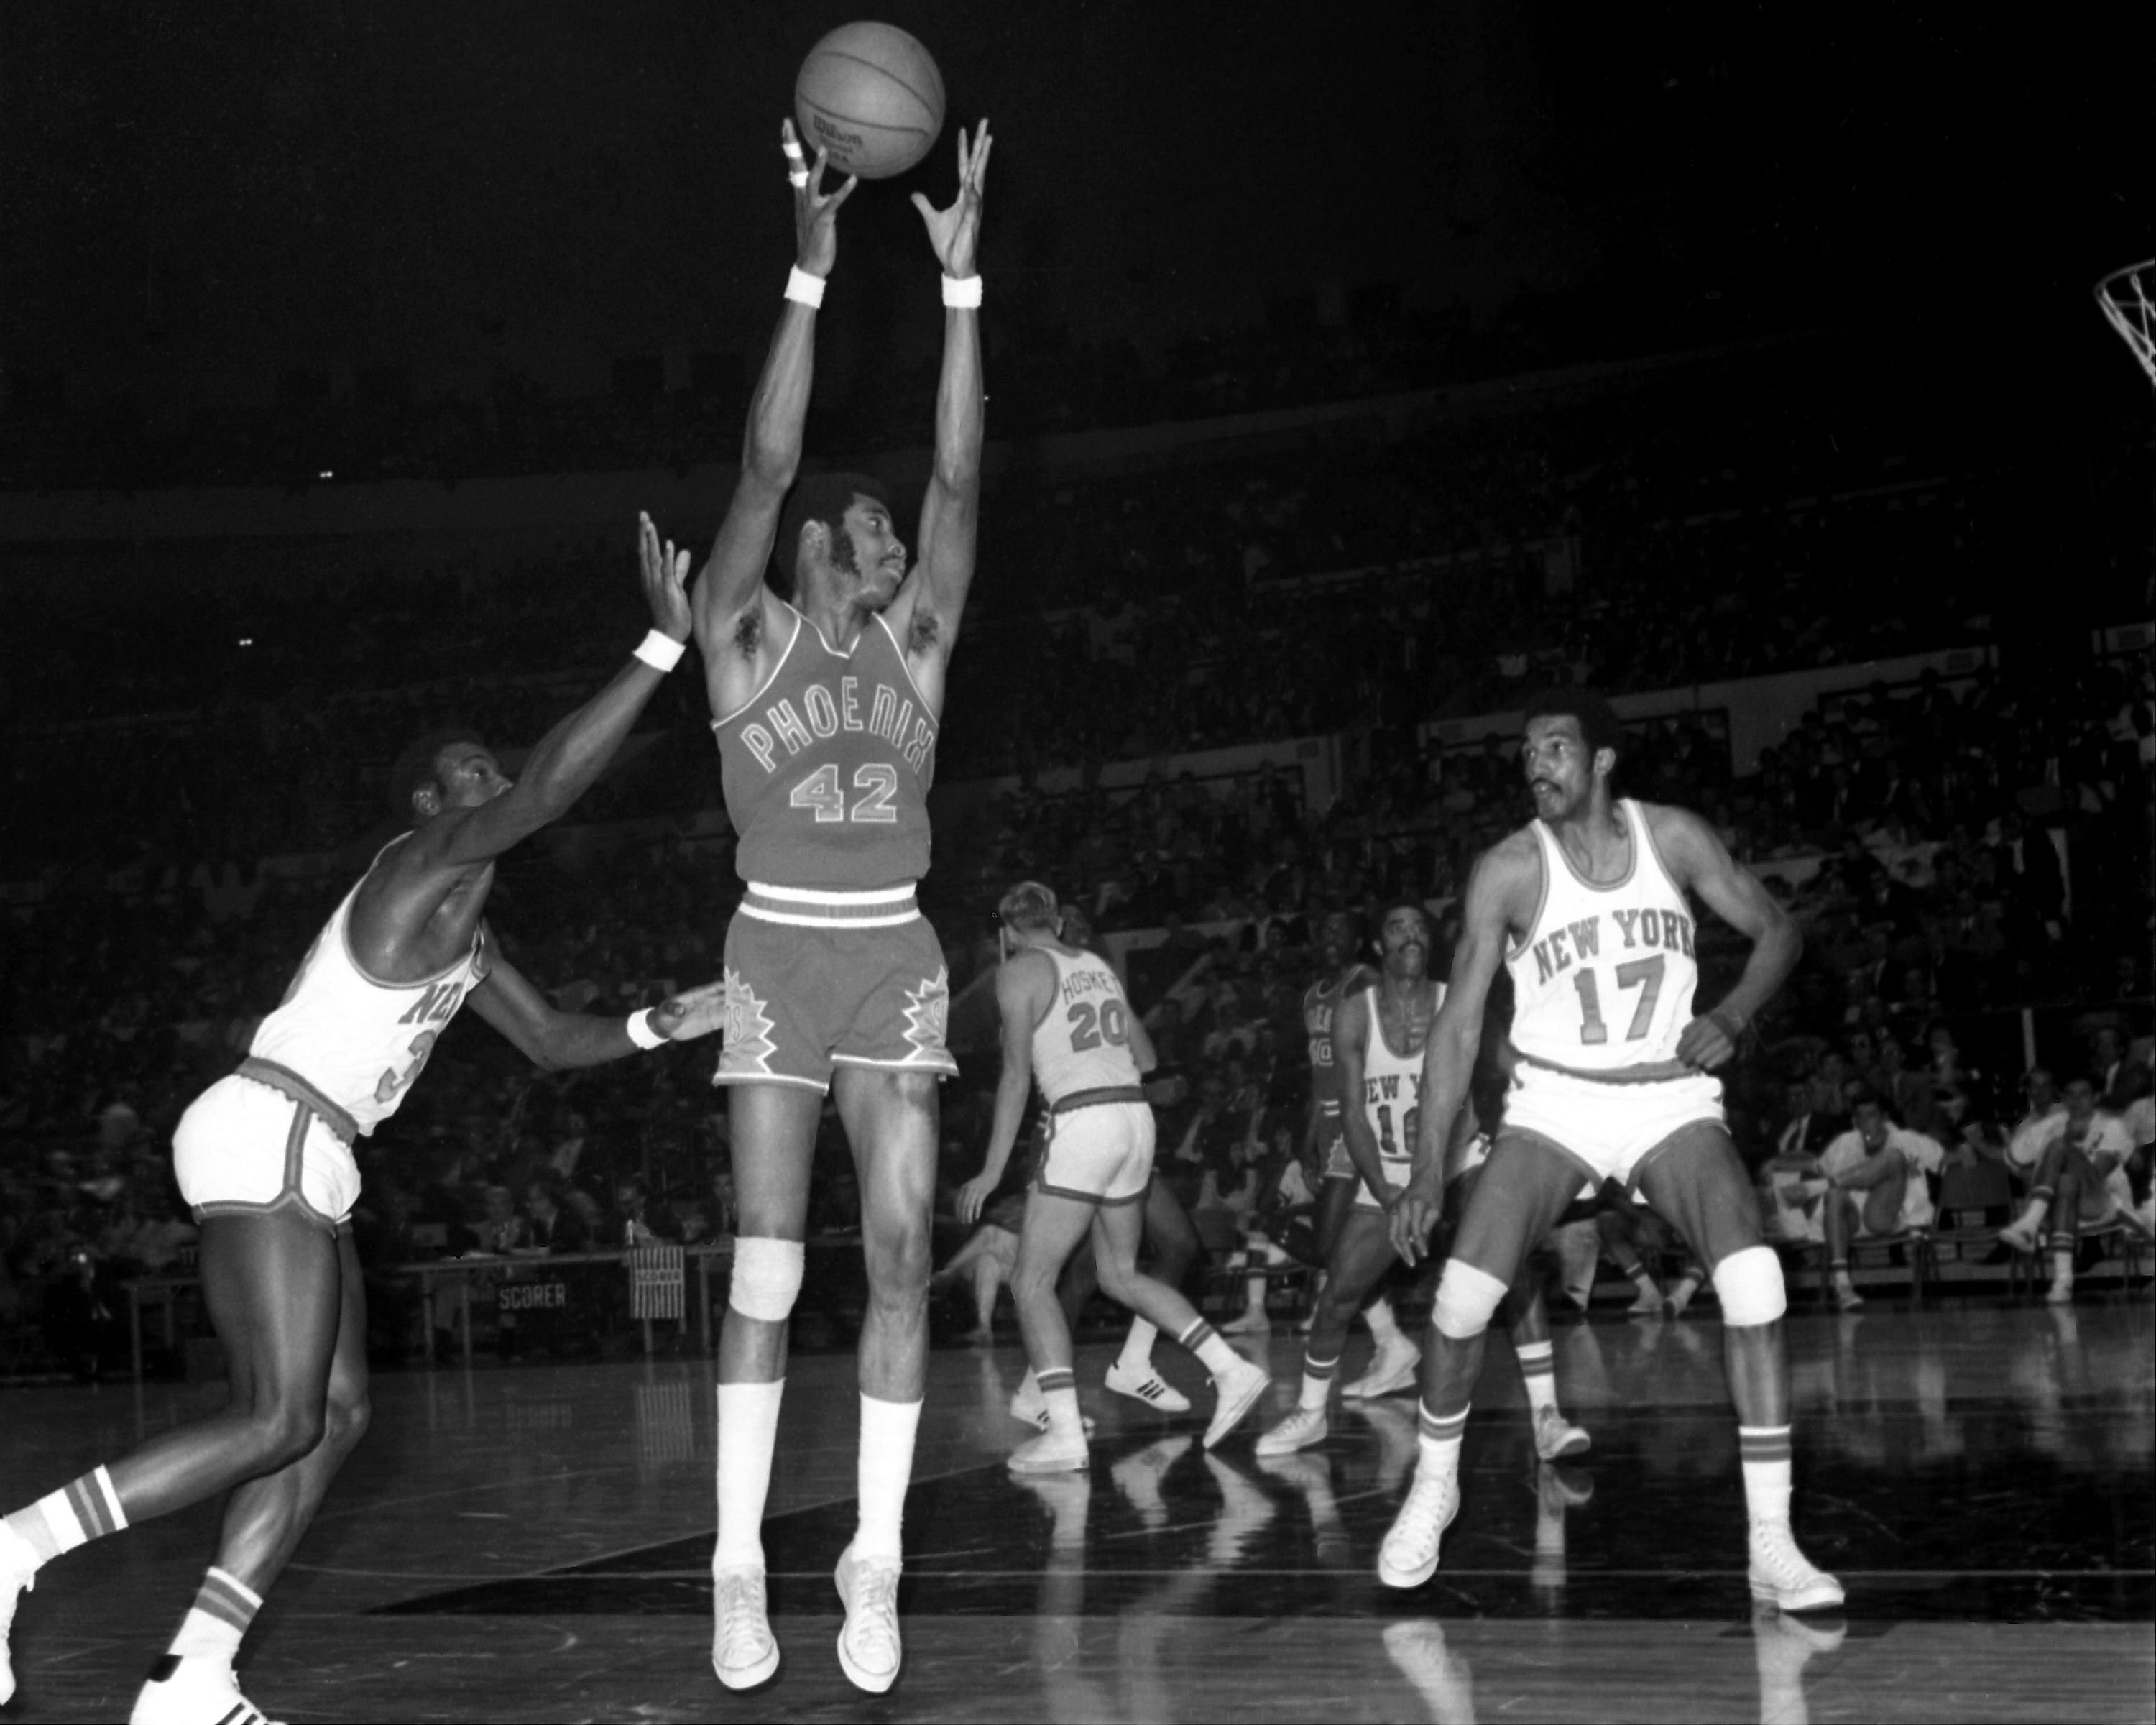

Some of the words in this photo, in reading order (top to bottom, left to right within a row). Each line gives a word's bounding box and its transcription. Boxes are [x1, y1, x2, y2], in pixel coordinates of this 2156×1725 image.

[740, 676, 934, 774] PHOENIX
[790, 763, 898, 822] 42
[1533, 915, 1600, 986] NEW
[1612, 907, 1696, 960] YORK
[1067, 998, 1126, 1053] 20
[1573, 953, 1665, 1046] 17
[499, 1283, 566, 1310] SCORER
